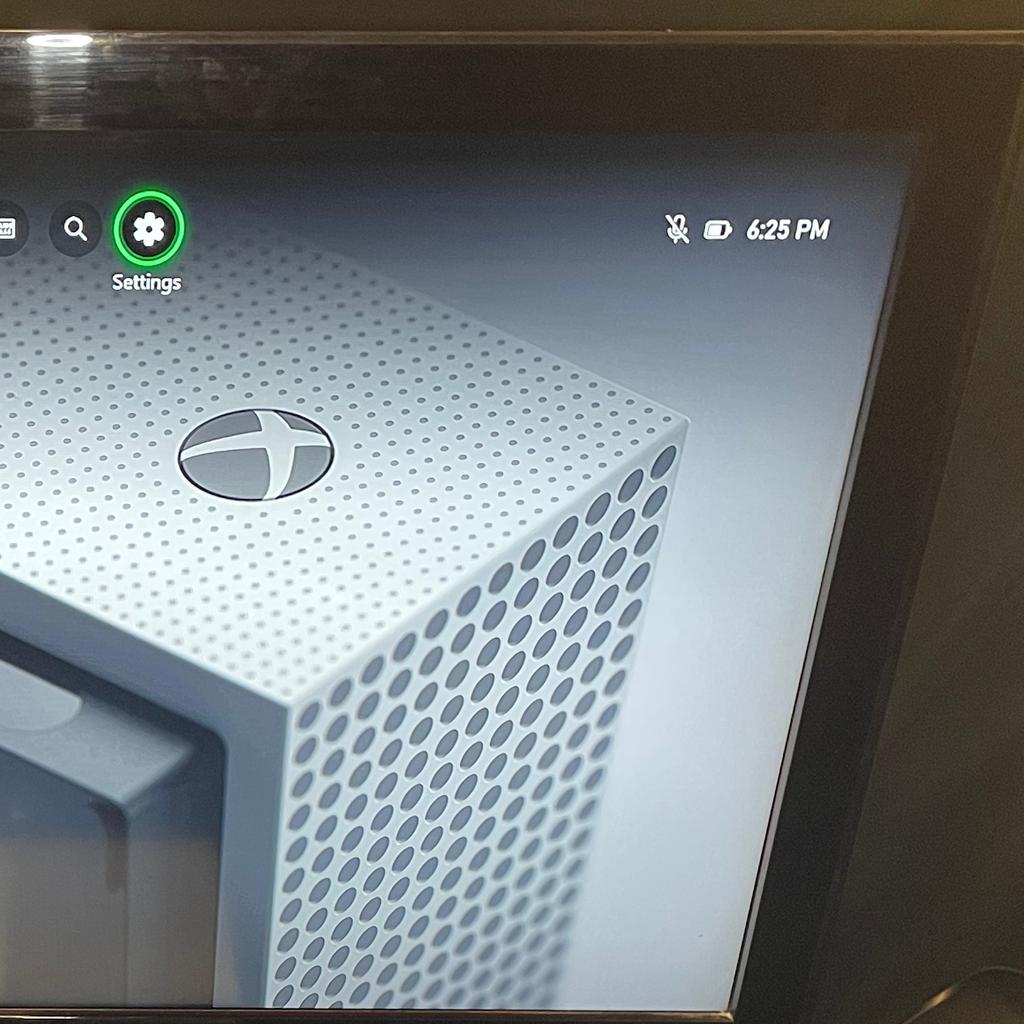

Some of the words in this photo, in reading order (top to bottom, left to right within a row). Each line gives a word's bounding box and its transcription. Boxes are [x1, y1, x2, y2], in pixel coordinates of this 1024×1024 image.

[746, 218, 791, 240] 6:25
[794, 218, 831, 240] PM
[112, 272, 182, 296] Settings
